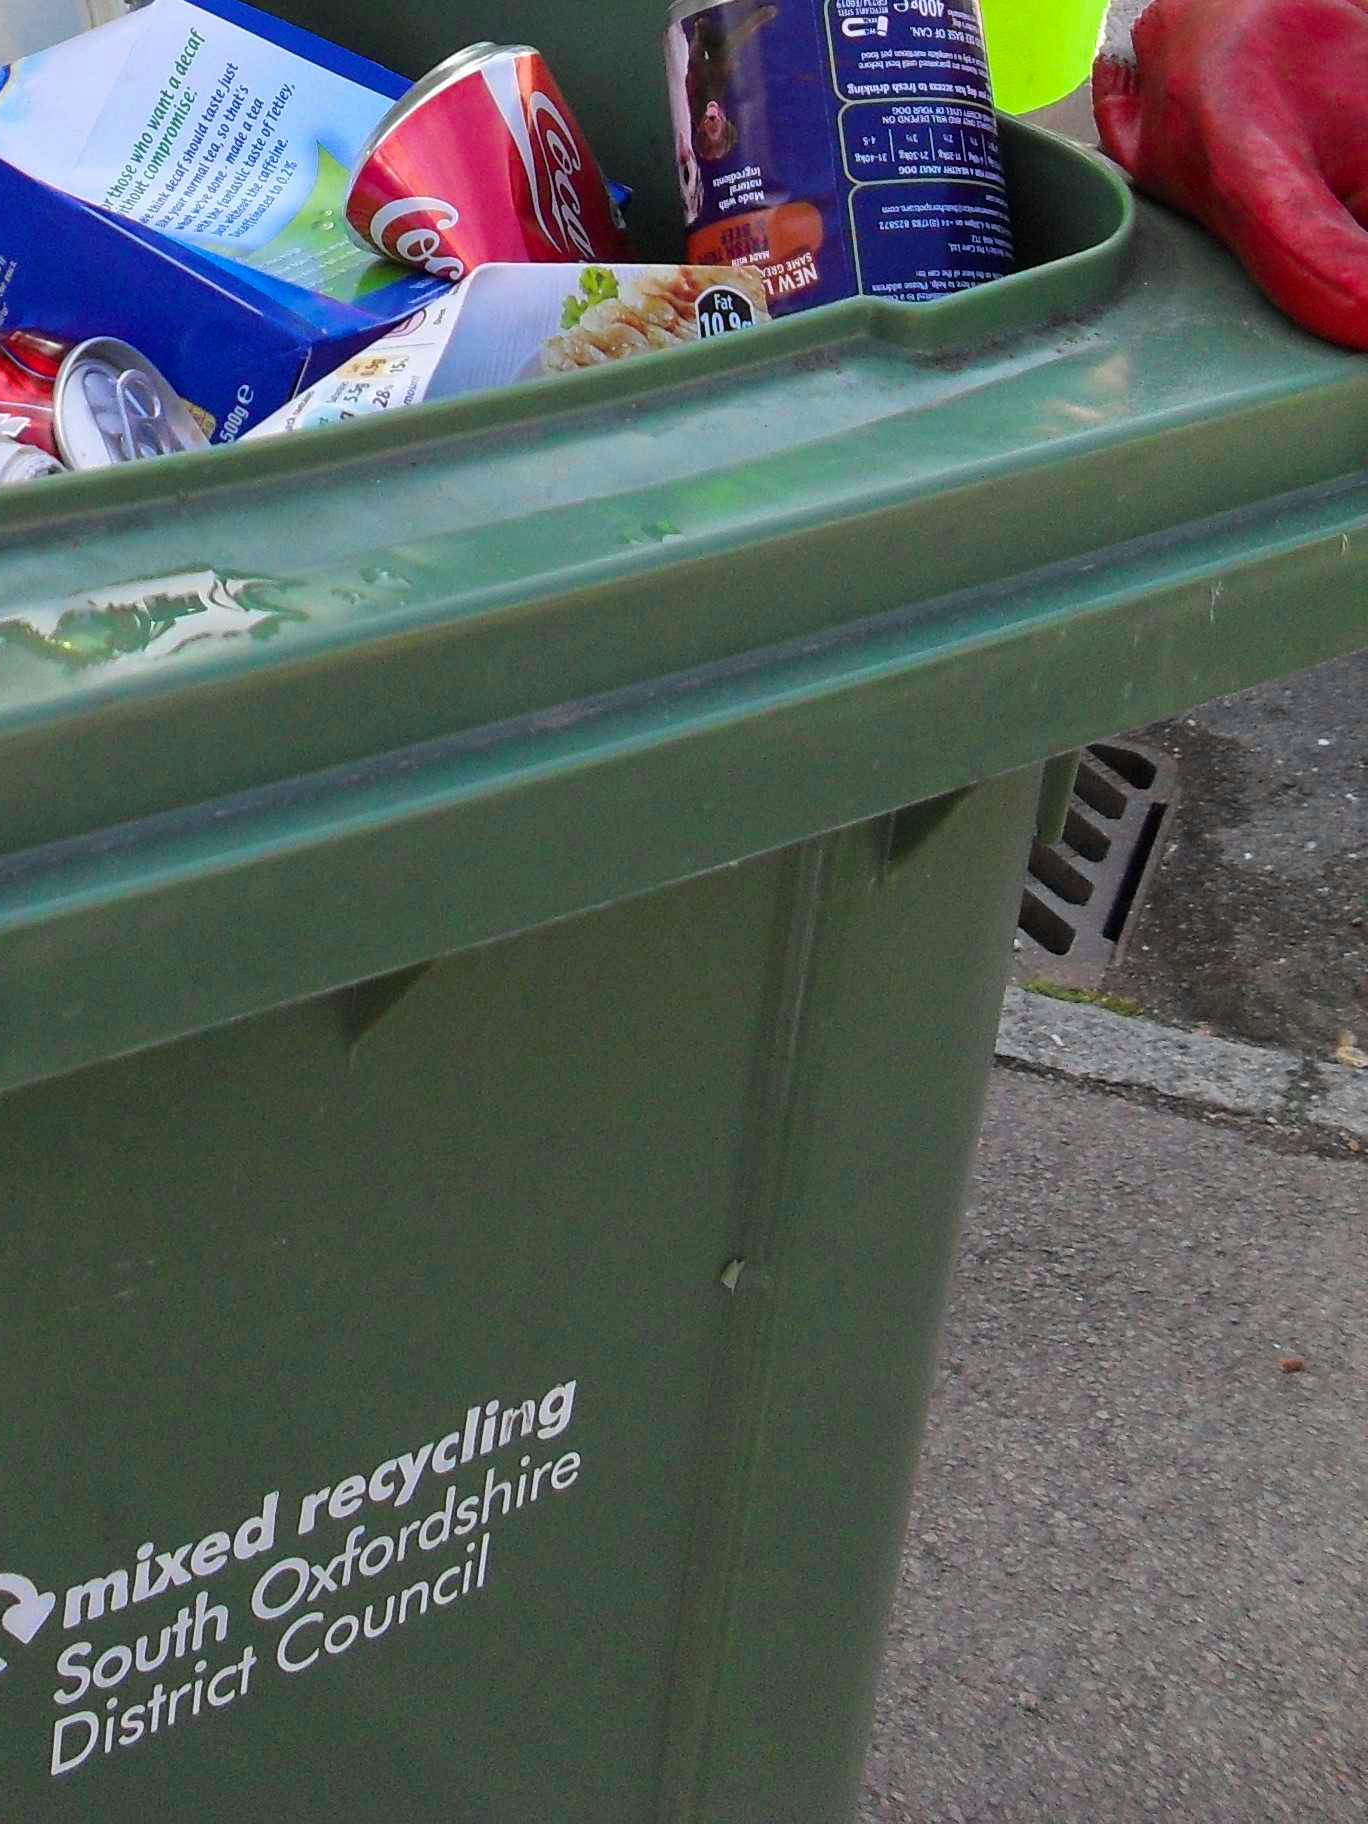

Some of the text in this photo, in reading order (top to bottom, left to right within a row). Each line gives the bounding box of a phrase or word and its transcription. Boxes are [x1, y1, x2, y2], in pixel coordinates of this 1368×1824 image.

[909, 26, 931, 37] CAN.
[935, 28, 945, 38] OF
[847, 82, 889, 94] drinking
[891, 82, 915, 93] fresh
[918, 82, 927, 91] to
[107, 165, 136, 197] those
[131, 133, 153, 163] who
[148, 90, 174, 129] want
[169, 76, 181, 89] a
[175, 28, 204, 75] decaf
[246, 98, 264, 120] tea
[266, 84, 295, 121] Tetley,
[891, 106, 910, 114] DOG
[243, 121, 252, 131] a
[261, 120, 275, 137] of
[882, 115, 894, 123] ON
[898, 115, 929, 123] DEPEND
[147, 192, 170, 213] think
[166, 161, 189, 191] decaf
[183, 123, 208, 163] should
[202, 89, 225, 122] taste
[218, 63, 238, 91] just
[226, 132, 247, 164] made
[116, 87, 196, 213] ithout compromise:
[168, 197, 187, 216] your
[184, 162, 209, 197] normal
[203, 143, 224, 162] tea,
[217, 124, 229, 139] so
[223, 85, 248, 121] that's
[243, 138, 266, 167] taste
[245, 183, 263, 197] the
[259, 140, 288, 182] caffeine.
[269, 185, 283, 194] to
[276, 161, 297, 184] 0.2%
[898, 165, 916, 174] DOG
[208, 171, 227, 193] done
[217, 168, 250, 207] fantastic
[728, 179, 762, 194] natural
[737, 190, 765, 202] Made
[206, 208, 223, 220] the
[785, 251, 812, 269] SAME
[777, 263, 819, 291] NEW
[714, 293, 733, 310] Fat
[700, 312, 754, 337] 109
[220, 403, 249, 443] 500g
[62, 1380, 576, 1629] mixed recycling
[54, 1451, 580, 1704] South Oxfordshire
[51, 1533, 489, 1775] District Council
